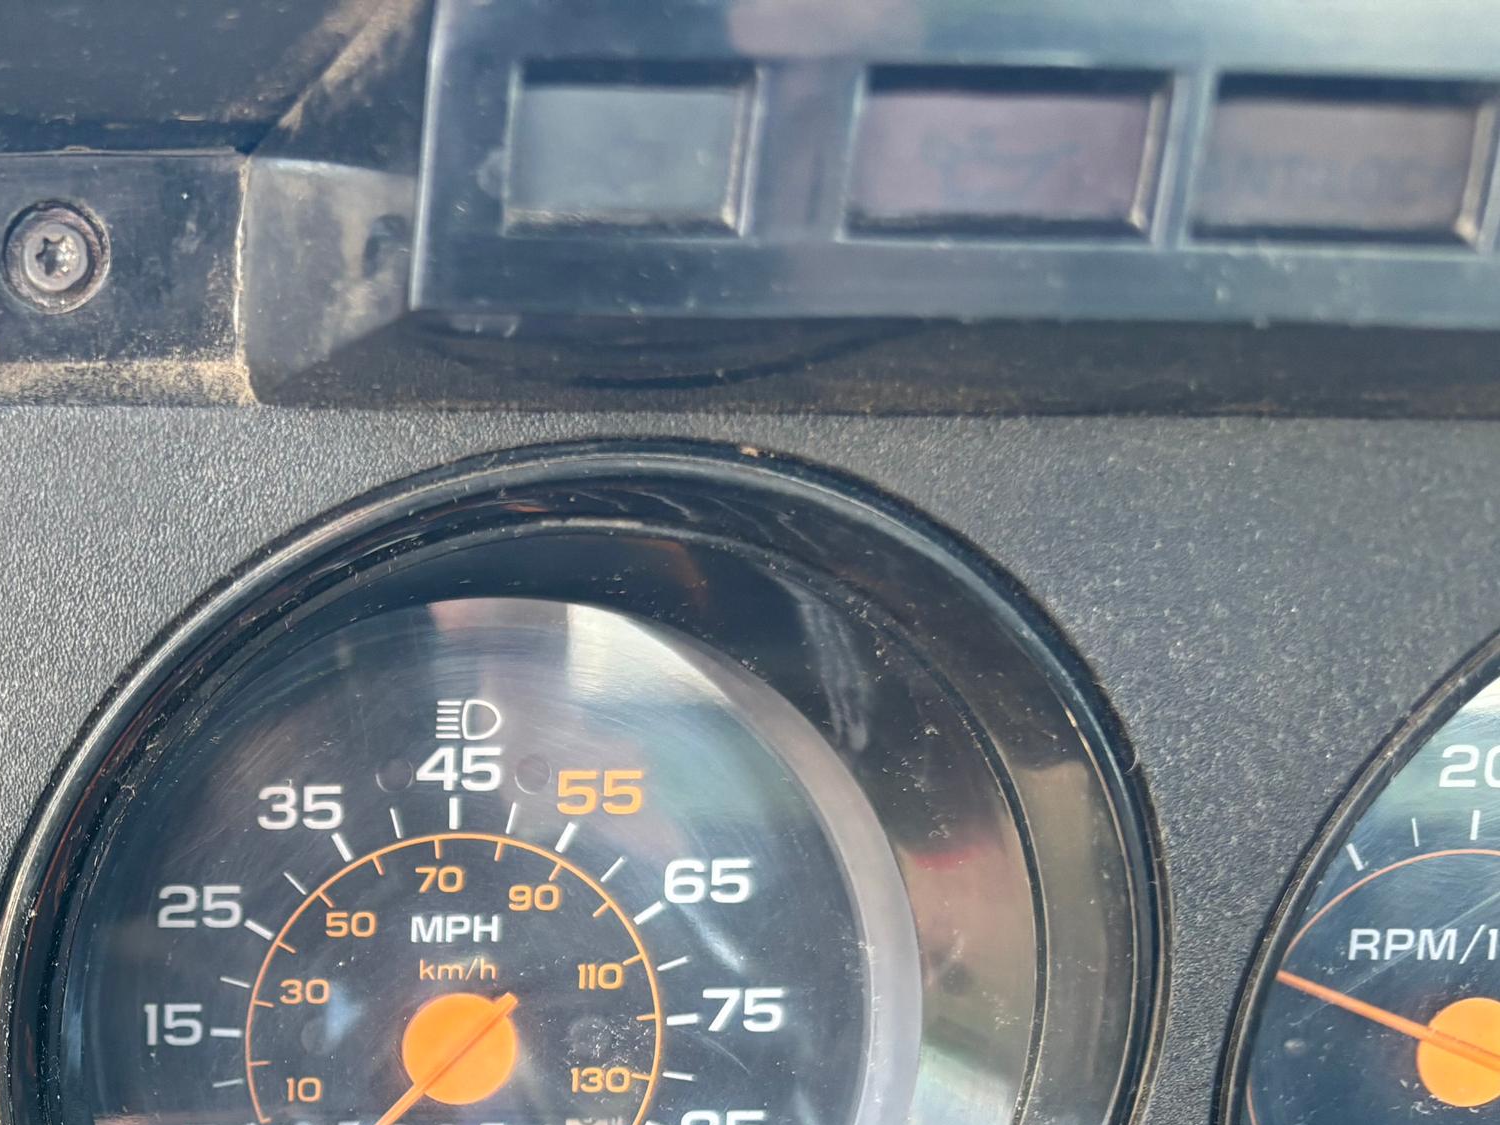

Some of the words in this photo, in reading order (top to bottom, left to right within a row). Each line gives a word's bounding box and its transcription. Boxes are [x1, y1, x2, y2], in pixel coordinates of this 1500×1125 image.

[416, 747, 502, 791] 45
[556, 770, 644, 815] 55
[258, 786, 343, 830] 35
[415, 866, 465, 893] 70
[664, 859, 752, 903] 65
[157, 885, 242, 928] 25
[508, 885, 561, 911] 90
[325, 911, 377, 938] 50
[411, 915, 500, 942] MPH
[419, 958, 498, 982] km/h
[577, 963, 624, 990] 110
[279, 979, 330, 1004] 30
[702, 987, 787, 1032] 75
[144, 1003, 203, 1046] 15
[286, 1077, 323, 1102] 10
[570, 1067, 632, 1093] 130
